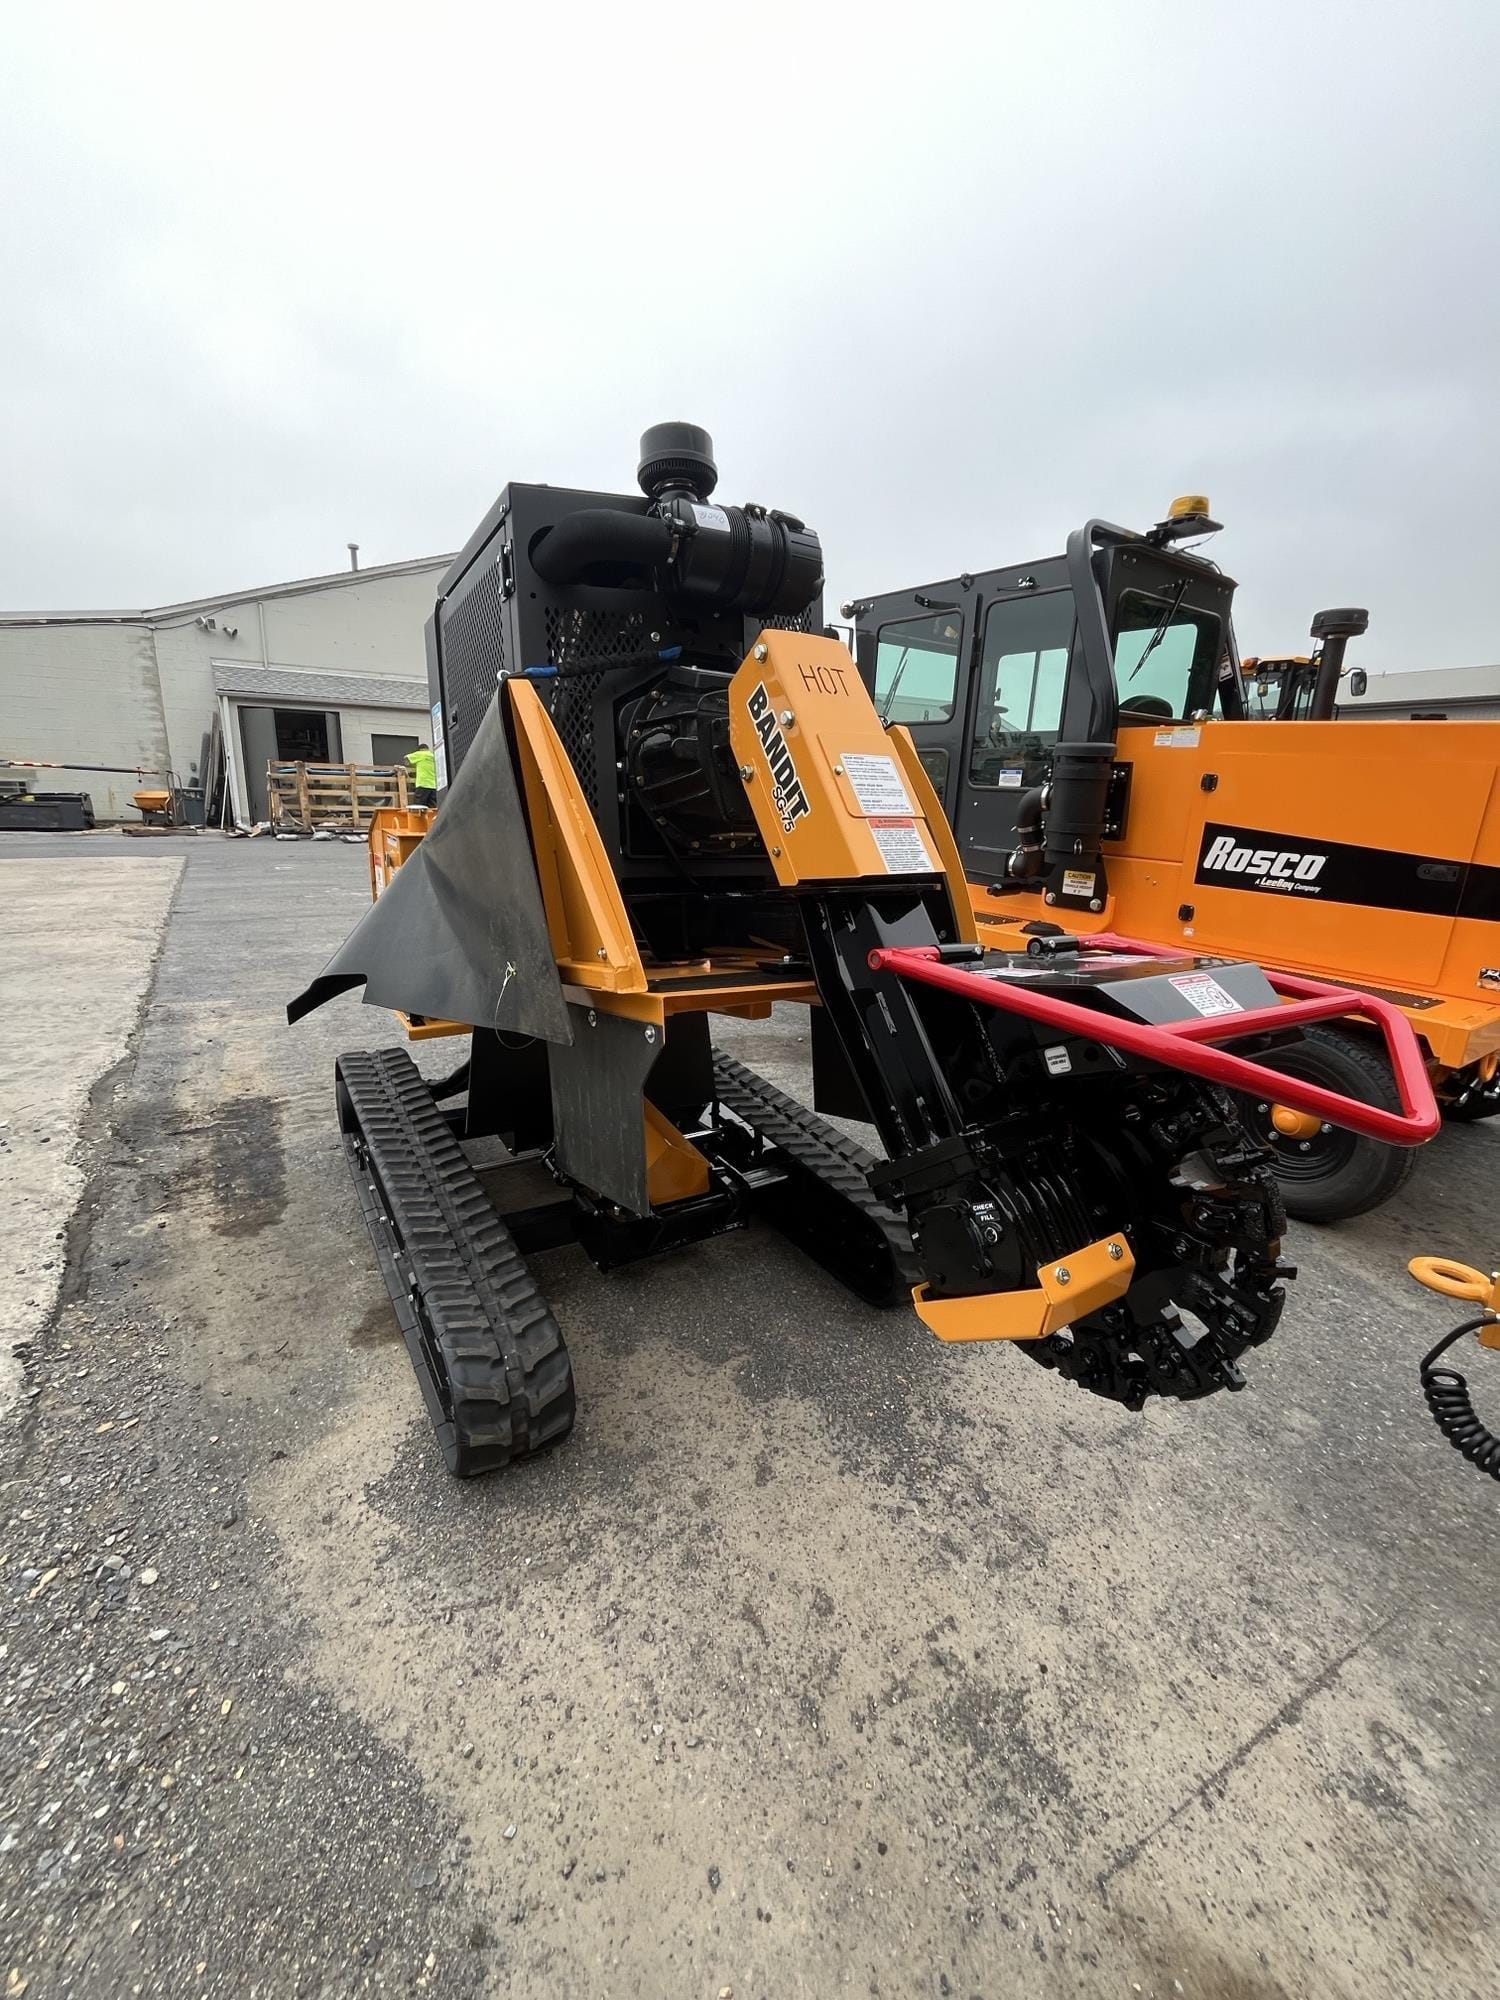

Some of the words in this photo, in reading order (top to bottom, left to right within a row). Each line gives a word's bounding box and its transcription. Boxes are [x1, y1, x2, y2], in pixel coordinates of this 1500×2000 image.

[798, 664, 849, 696] HOT
[747, 683, 810, 821] BANDIT
[772, 786, 795, 832] SG-75
[1067, 872, 1092, 880] CAUTION
[1260, 877, 1295, 891] LeeBoy
[1294, 882, 1321, 893] Company
[972, 1202, 994, 1211] CHECK
